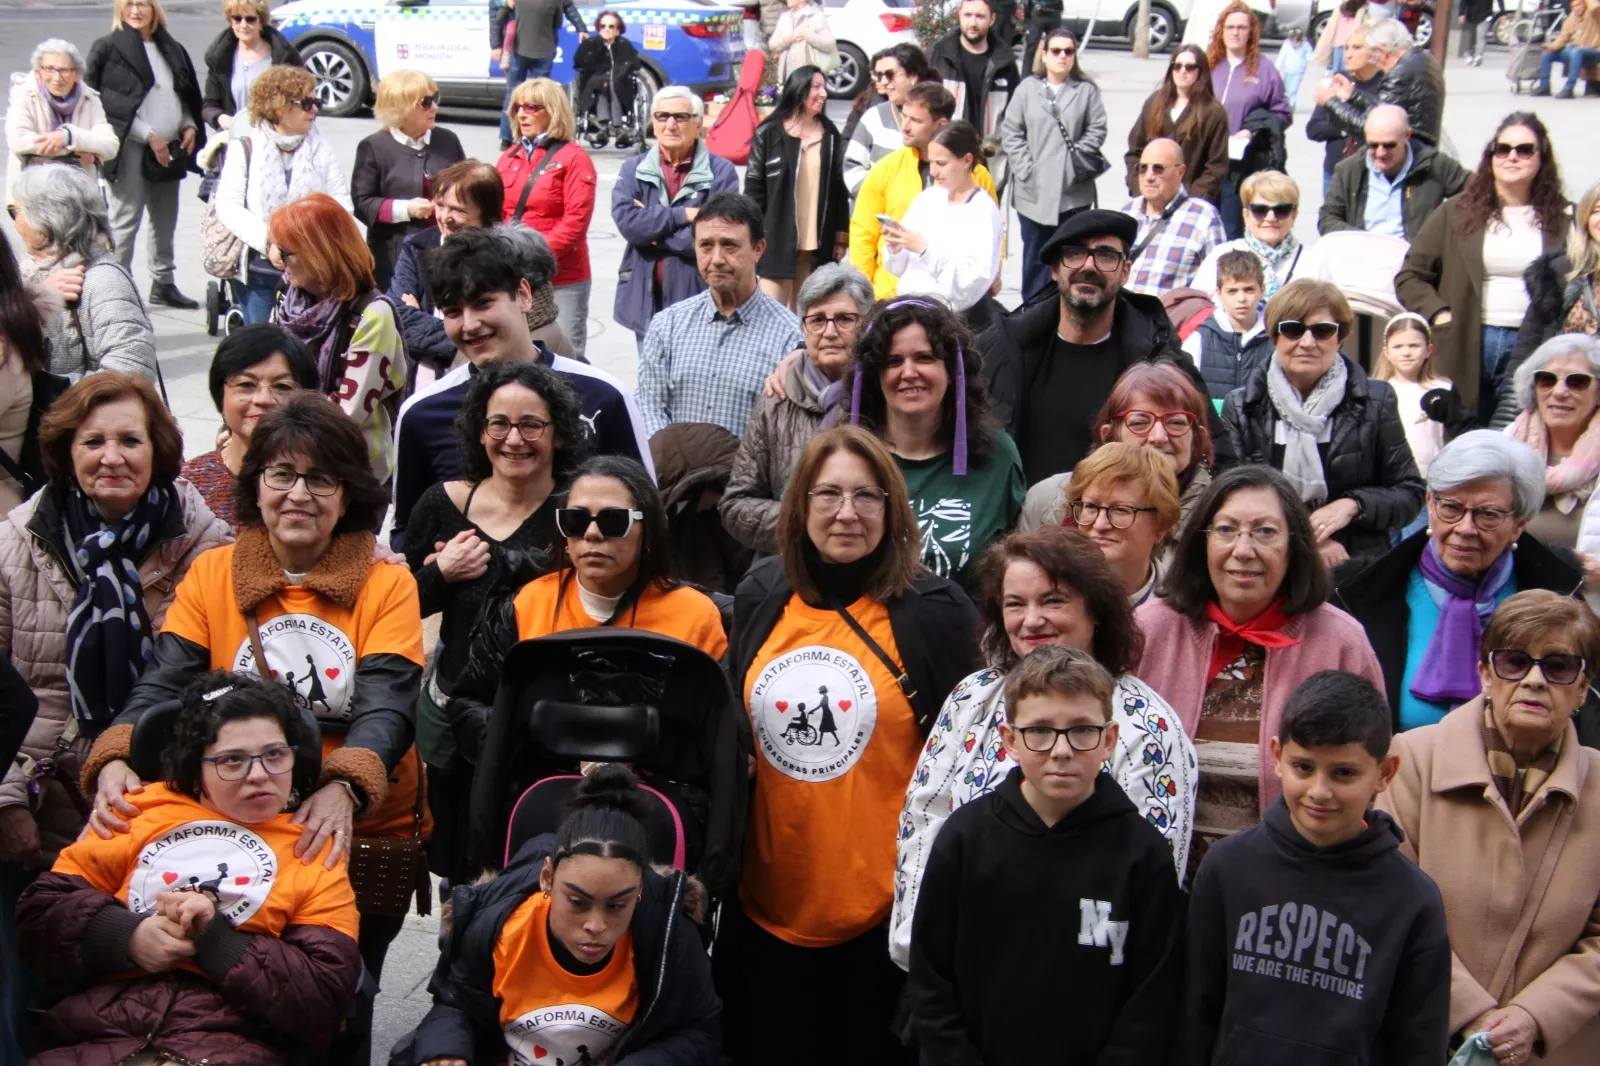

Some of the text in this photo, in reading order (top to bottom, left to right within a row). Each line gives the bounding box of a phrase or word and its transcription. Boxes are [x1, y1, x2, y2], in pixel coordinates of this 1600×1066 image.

[447, 44, 471, 52] LOCAL
[239, 619, 355, 668] PLAAFORMA ESTATAL
[755, 651, 870, 700] PLATAFORMA ESTATAL
[759, 726, 865, 776] CUIDADORAS PRINCIPALES
[142, 825, 274, 884] PLATAFORMA ESTATAL
[1235, 902, 1372, 979] RESPECT
[1232, 953, 1365, 1001] WE ARE THE FUTURE
